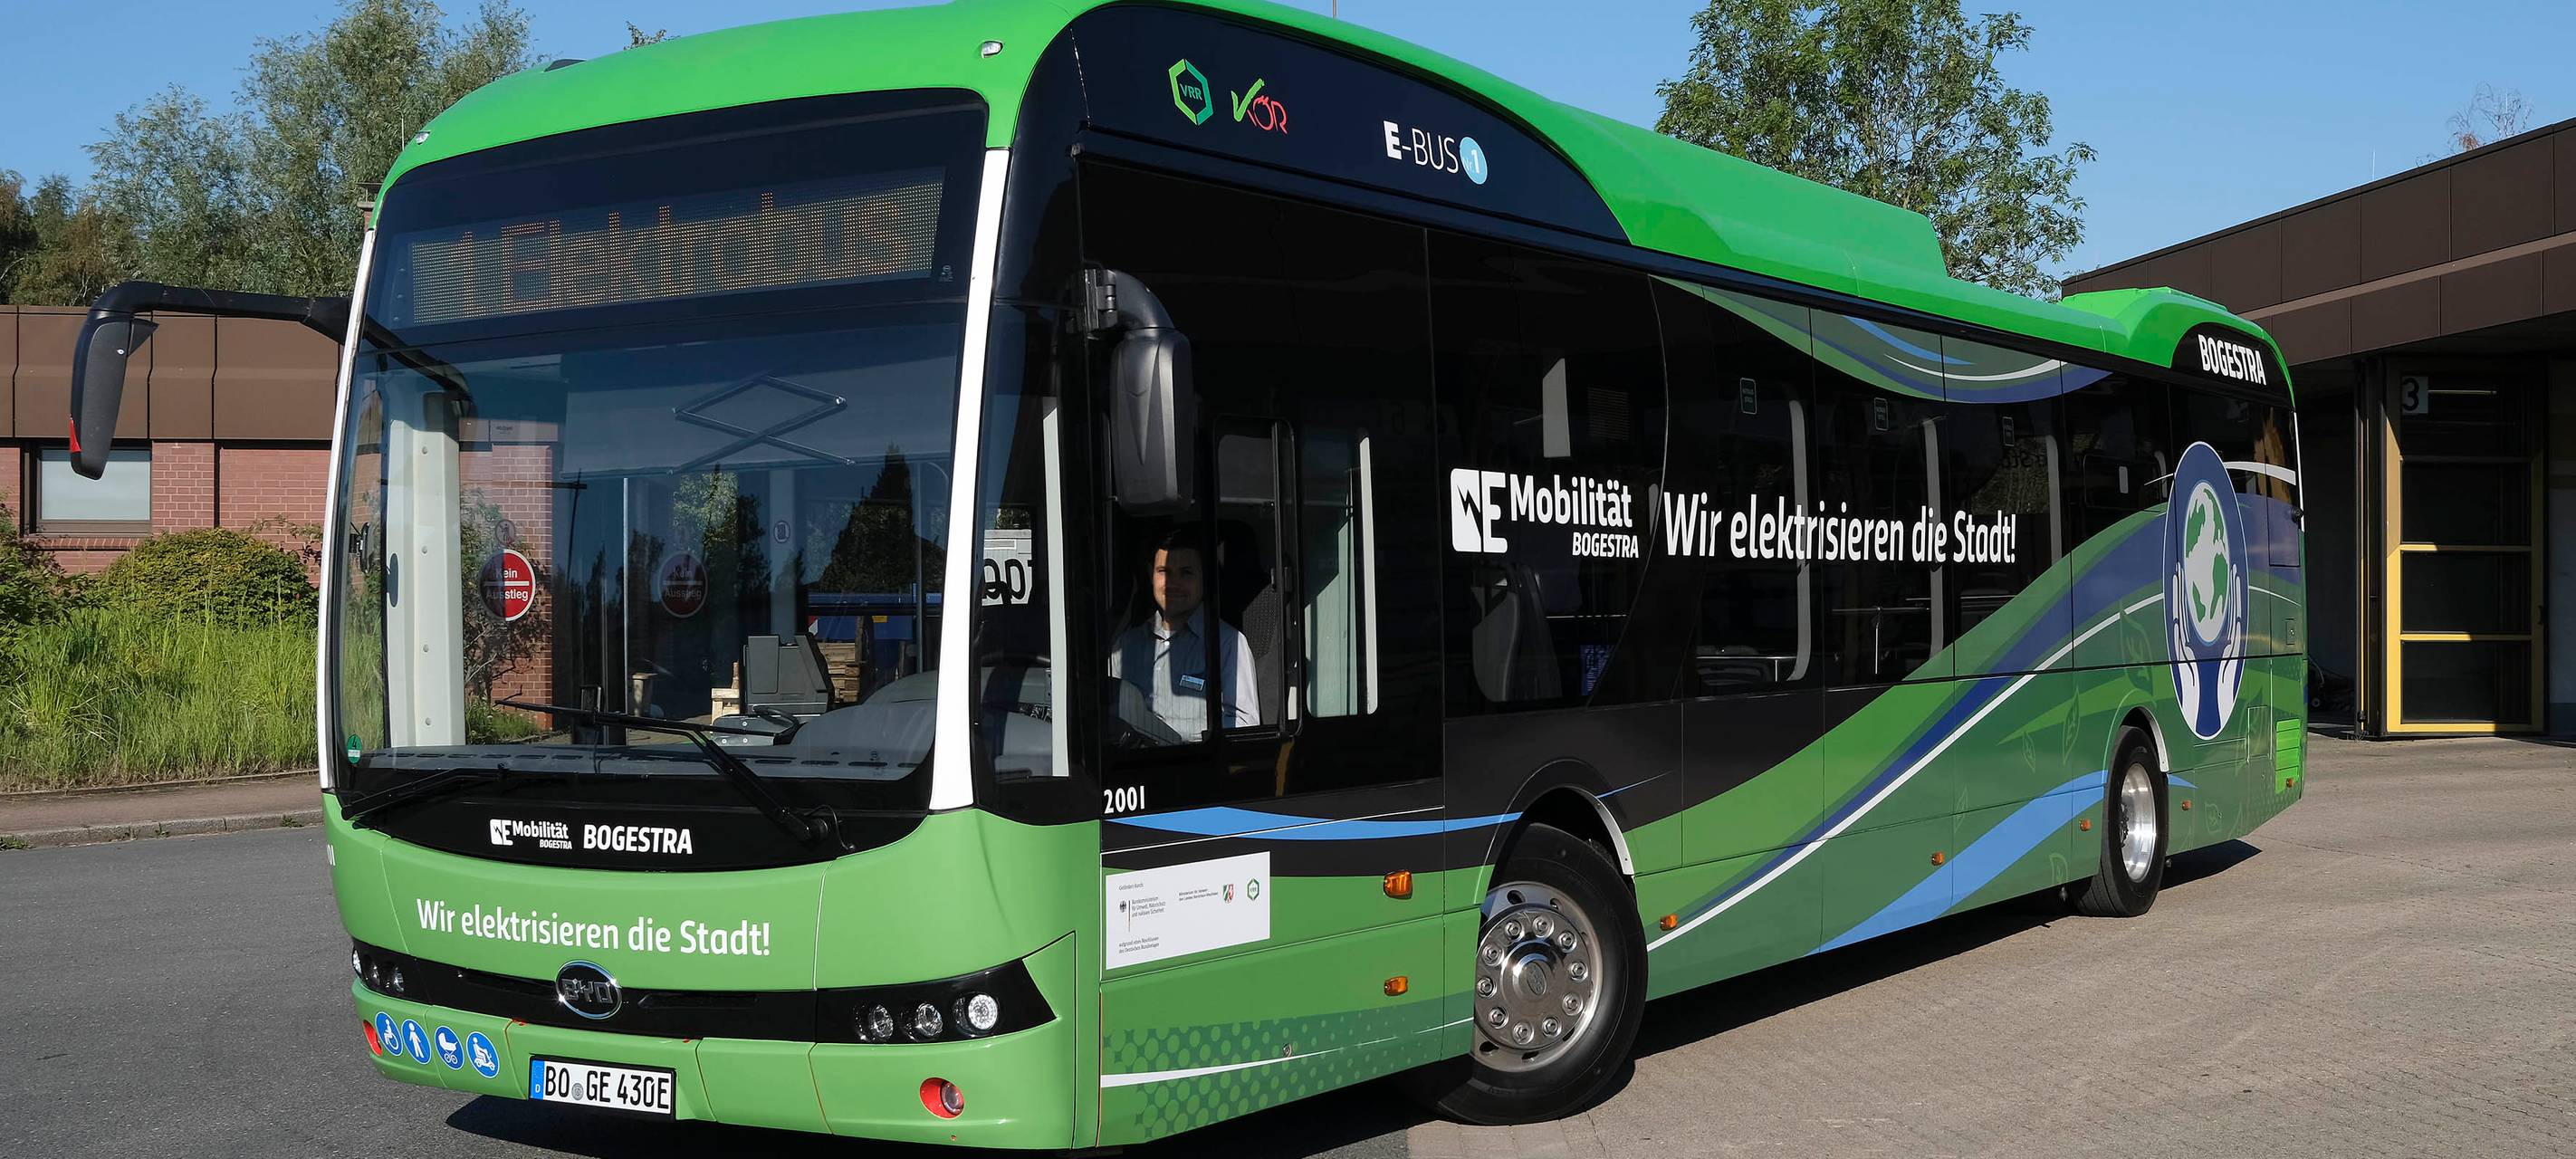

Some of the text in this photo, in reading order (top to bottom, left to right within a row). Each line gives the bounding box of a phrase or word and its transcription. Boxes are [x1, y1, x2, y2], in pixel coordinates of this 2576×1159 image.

[1180, 82, 1202, 101] VRR
[1384, 120, 1459, 174] E-BUS
[501, 191, 908, 313] Elektrobus
[2198, 334, 2266, 385] BOGESTRA
[2401, 378, 2419, 411] 3
[1510, 474, 1633, 528] Mobilität
[1664, 492, 2016, 563] Wir elektrisieren die Stadt!
[1572, 532, 1639, 558] BOGESTRA
[495, 568, 518, 579] Kein
[486, 589, 529, 601] Ausstieg
[1104, 786, 1145, 814] 2001
[512, 820, 570, 839] Mobilität
[539, 838, 572, 849] BOGESTRA
[582, 824, 694, 854] BOGESTRA
[417, 898, 771, 956] Wir elektrisieren die Stadt!
[561, 978, 614, 1004] BYD
[545, 1066, 570, 1097] BO
[586, 1070, 611, 1103] GE
[617, 1074, 670, 1109] 430E
